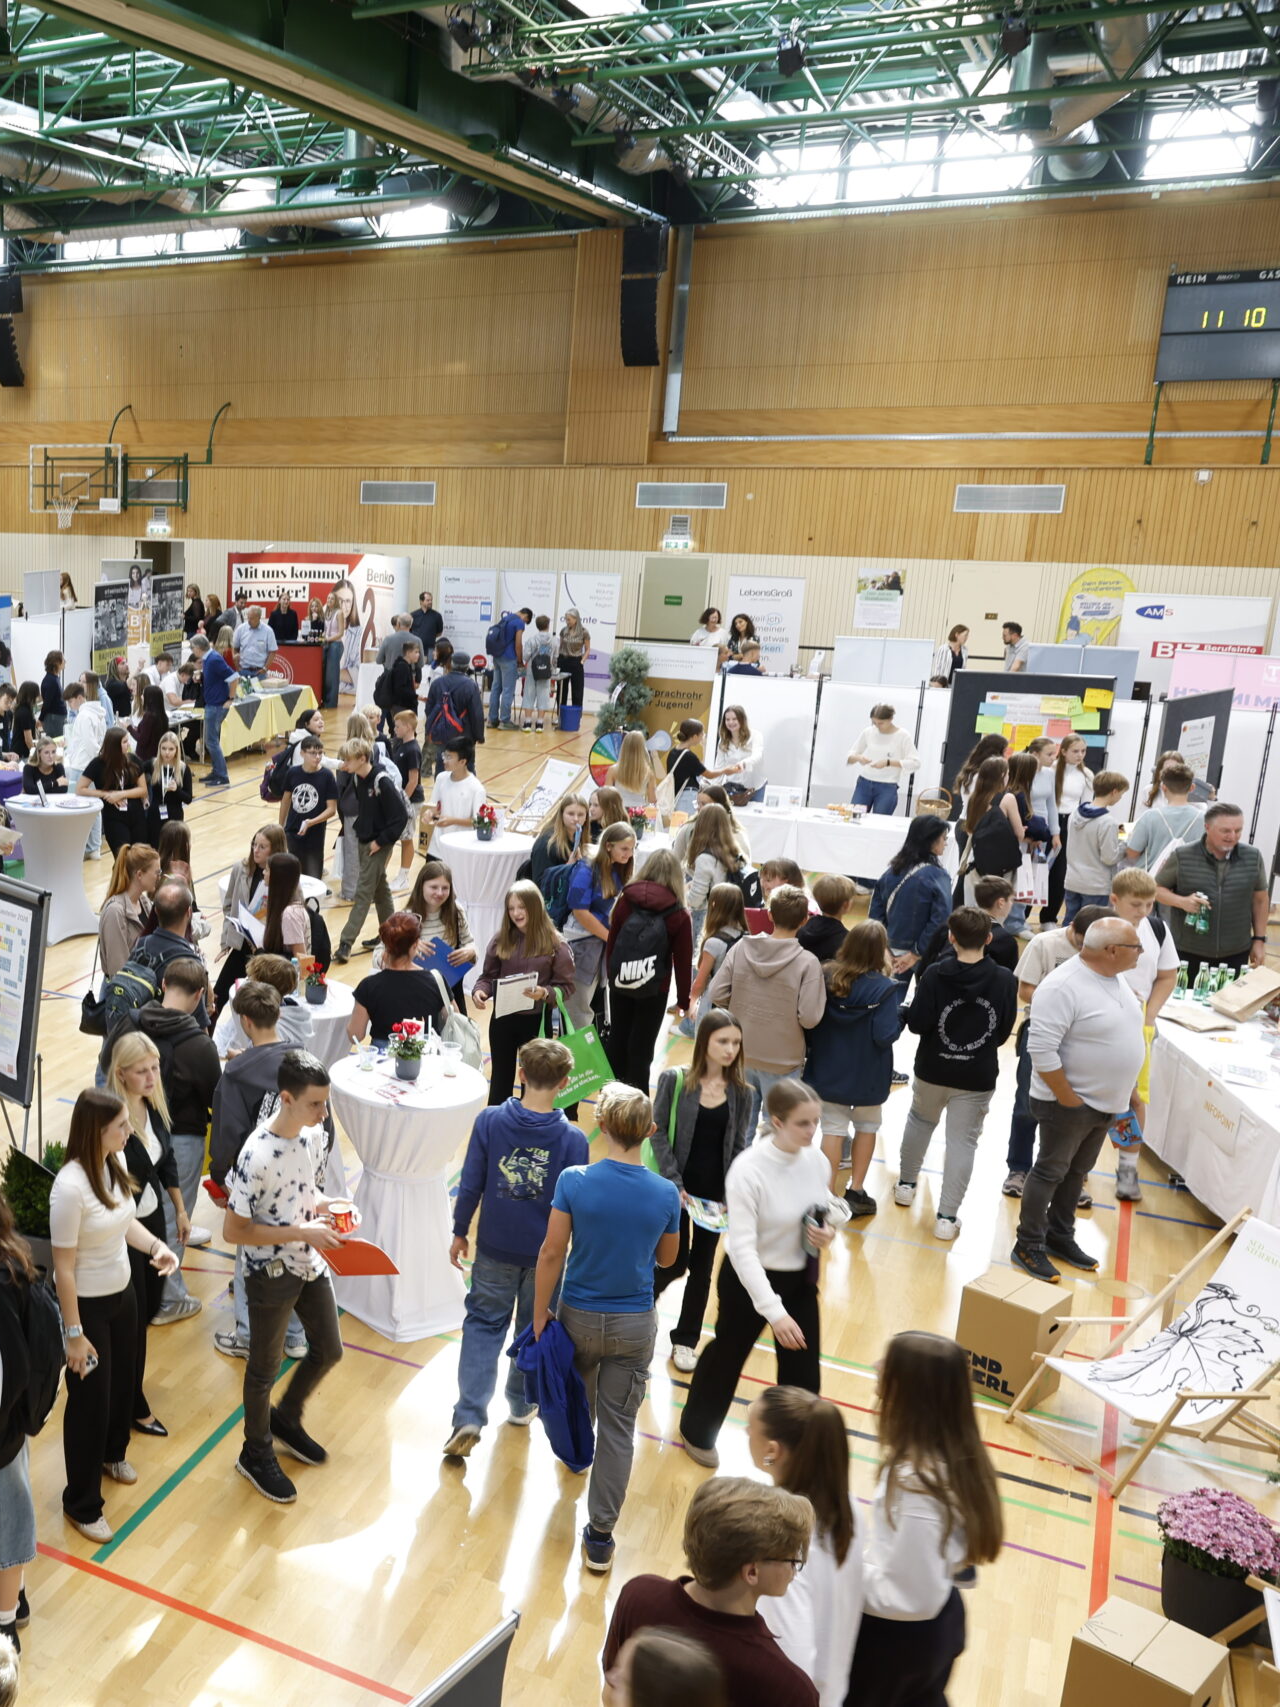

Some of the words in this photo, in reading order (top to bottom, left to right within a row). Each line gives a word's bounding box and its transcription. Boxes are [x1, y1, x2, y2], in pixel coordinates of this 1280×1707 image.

[1176, 274, 1207, 285] HEIM
[1244, 307, 1267, 328] 10
[236, 566, 258, 580] Mit
[262, 567, 287, 580] uns
[291, 565, 346, 580] kommst
[367, 568, 395, 585] Benko
[256, 585, 307, 599] weiter!
[739, 588, 793, 598] LebensGroß
[1144, 605, 1175, 617] AMS
[1203, 644, 1257, 655] Berufsinfo
[655, 700, 693, 710] Jugend!
[619, 954, 658, 982] NIKE
[1203, 1100, 1235, 1133] INFOPOINT
